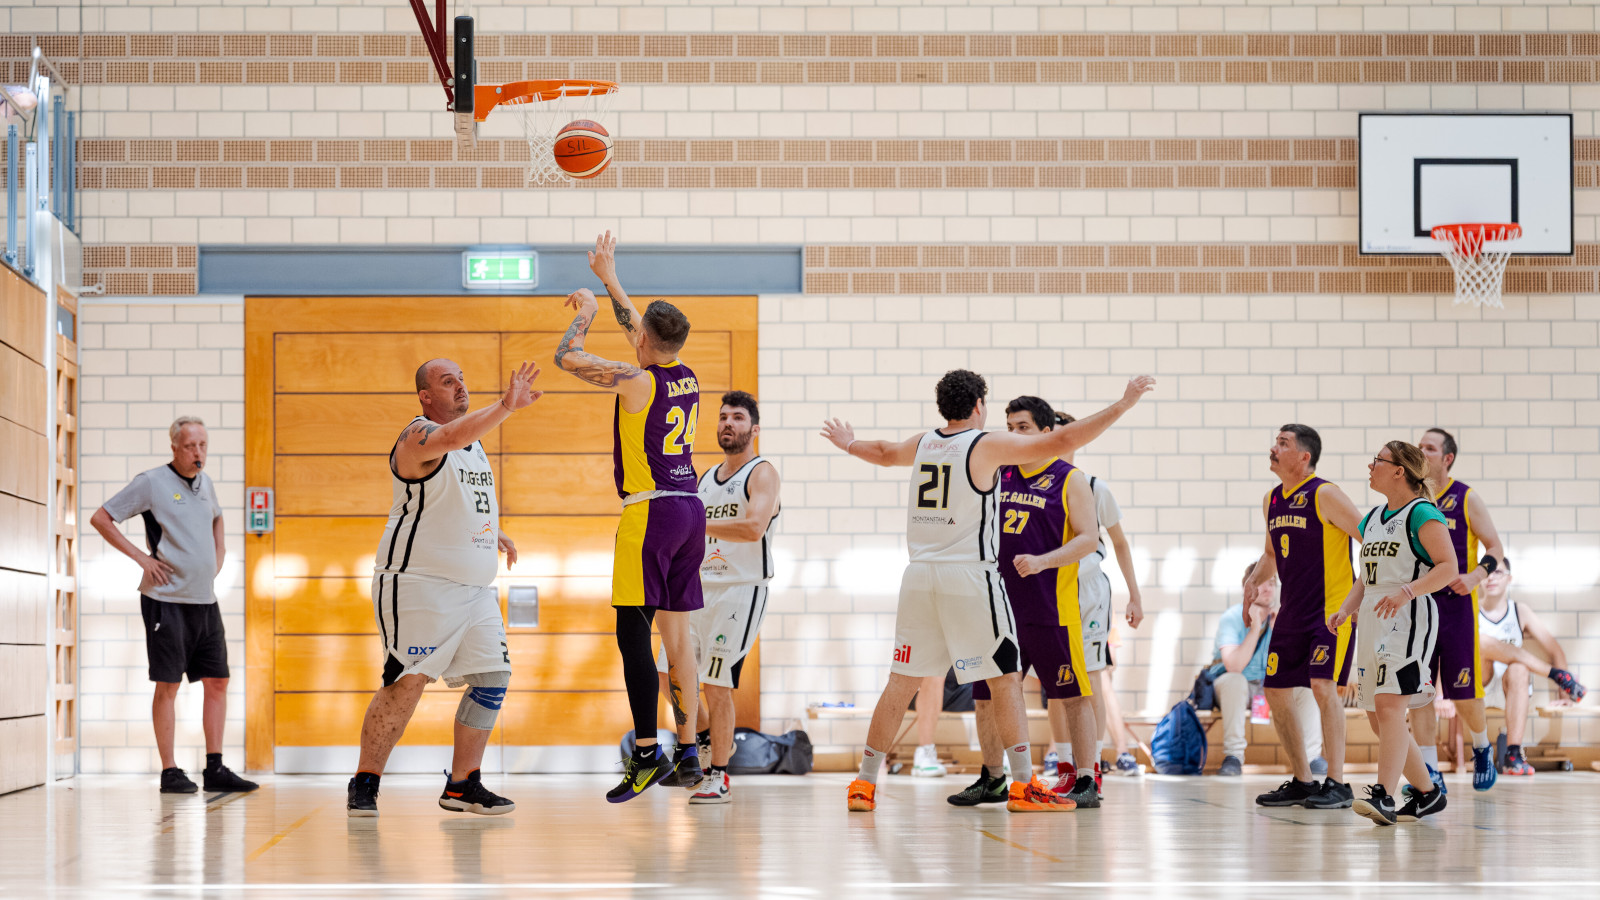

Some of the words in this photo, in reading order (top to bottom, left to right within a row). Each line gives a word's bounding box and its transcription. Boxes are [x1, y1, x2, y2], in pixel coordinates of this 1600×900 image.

[567, 140, 591, 153] SIL
[666, 377, 698, 398] LAKERS
[663, 402, 699, 455] 24
[917, 462, 953, 510] 21
[474, 490, 490, 514] 23
[705, 504, 739, 519] GERS
[1003, 509, 1030, 535] 27
[1280, 533, 1290, 559] 9
[1360, 541, 1401, 558] IGERS
[1092, 641, 1101, 662] 7
[708, 656, 724, 679] 11
[1266, 652, 1279, 676] 9
